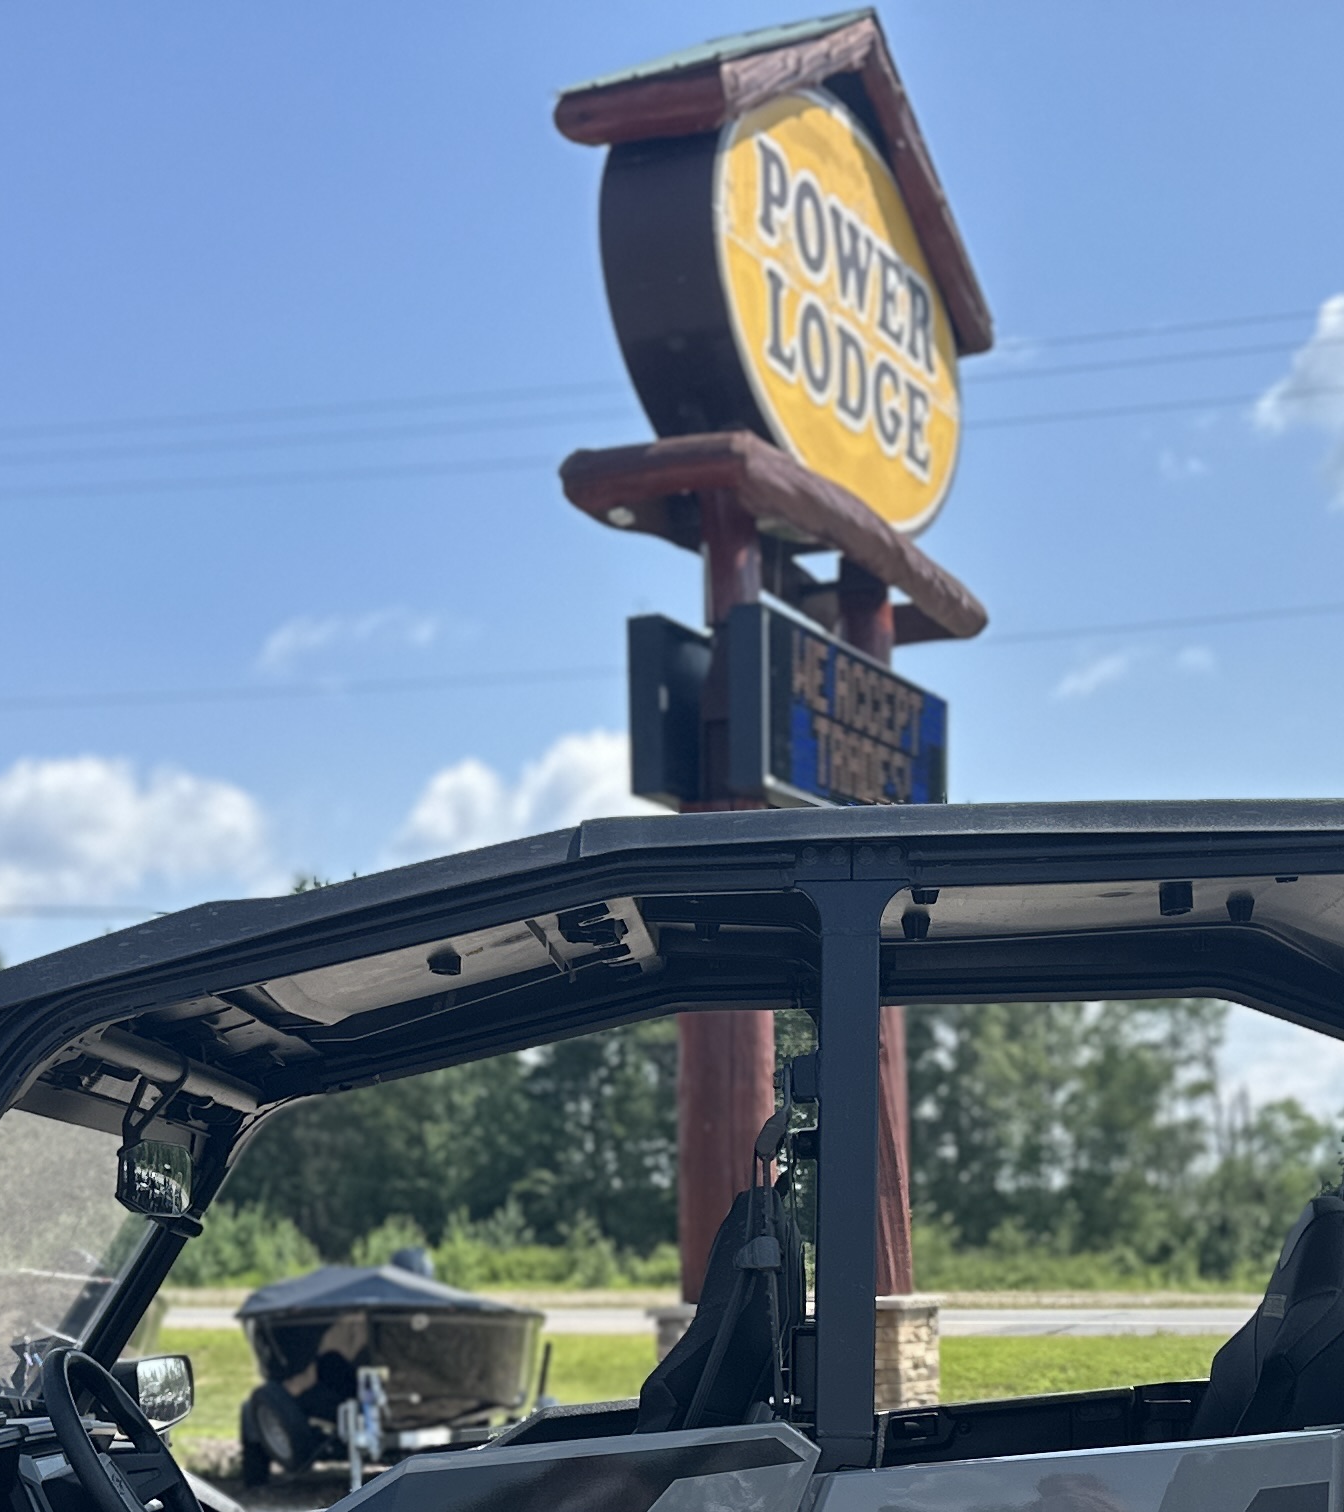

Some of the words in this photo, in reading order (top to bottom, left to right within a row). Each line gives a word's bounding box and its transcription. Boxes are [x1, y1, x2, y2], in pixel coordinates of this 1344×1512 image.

[758, 137, 935, 376] POWER
[766, 268, 930, 474] LODGE
[792, 629, 828, 713] WE
[834, 652, 924, 757] ACCEPT
